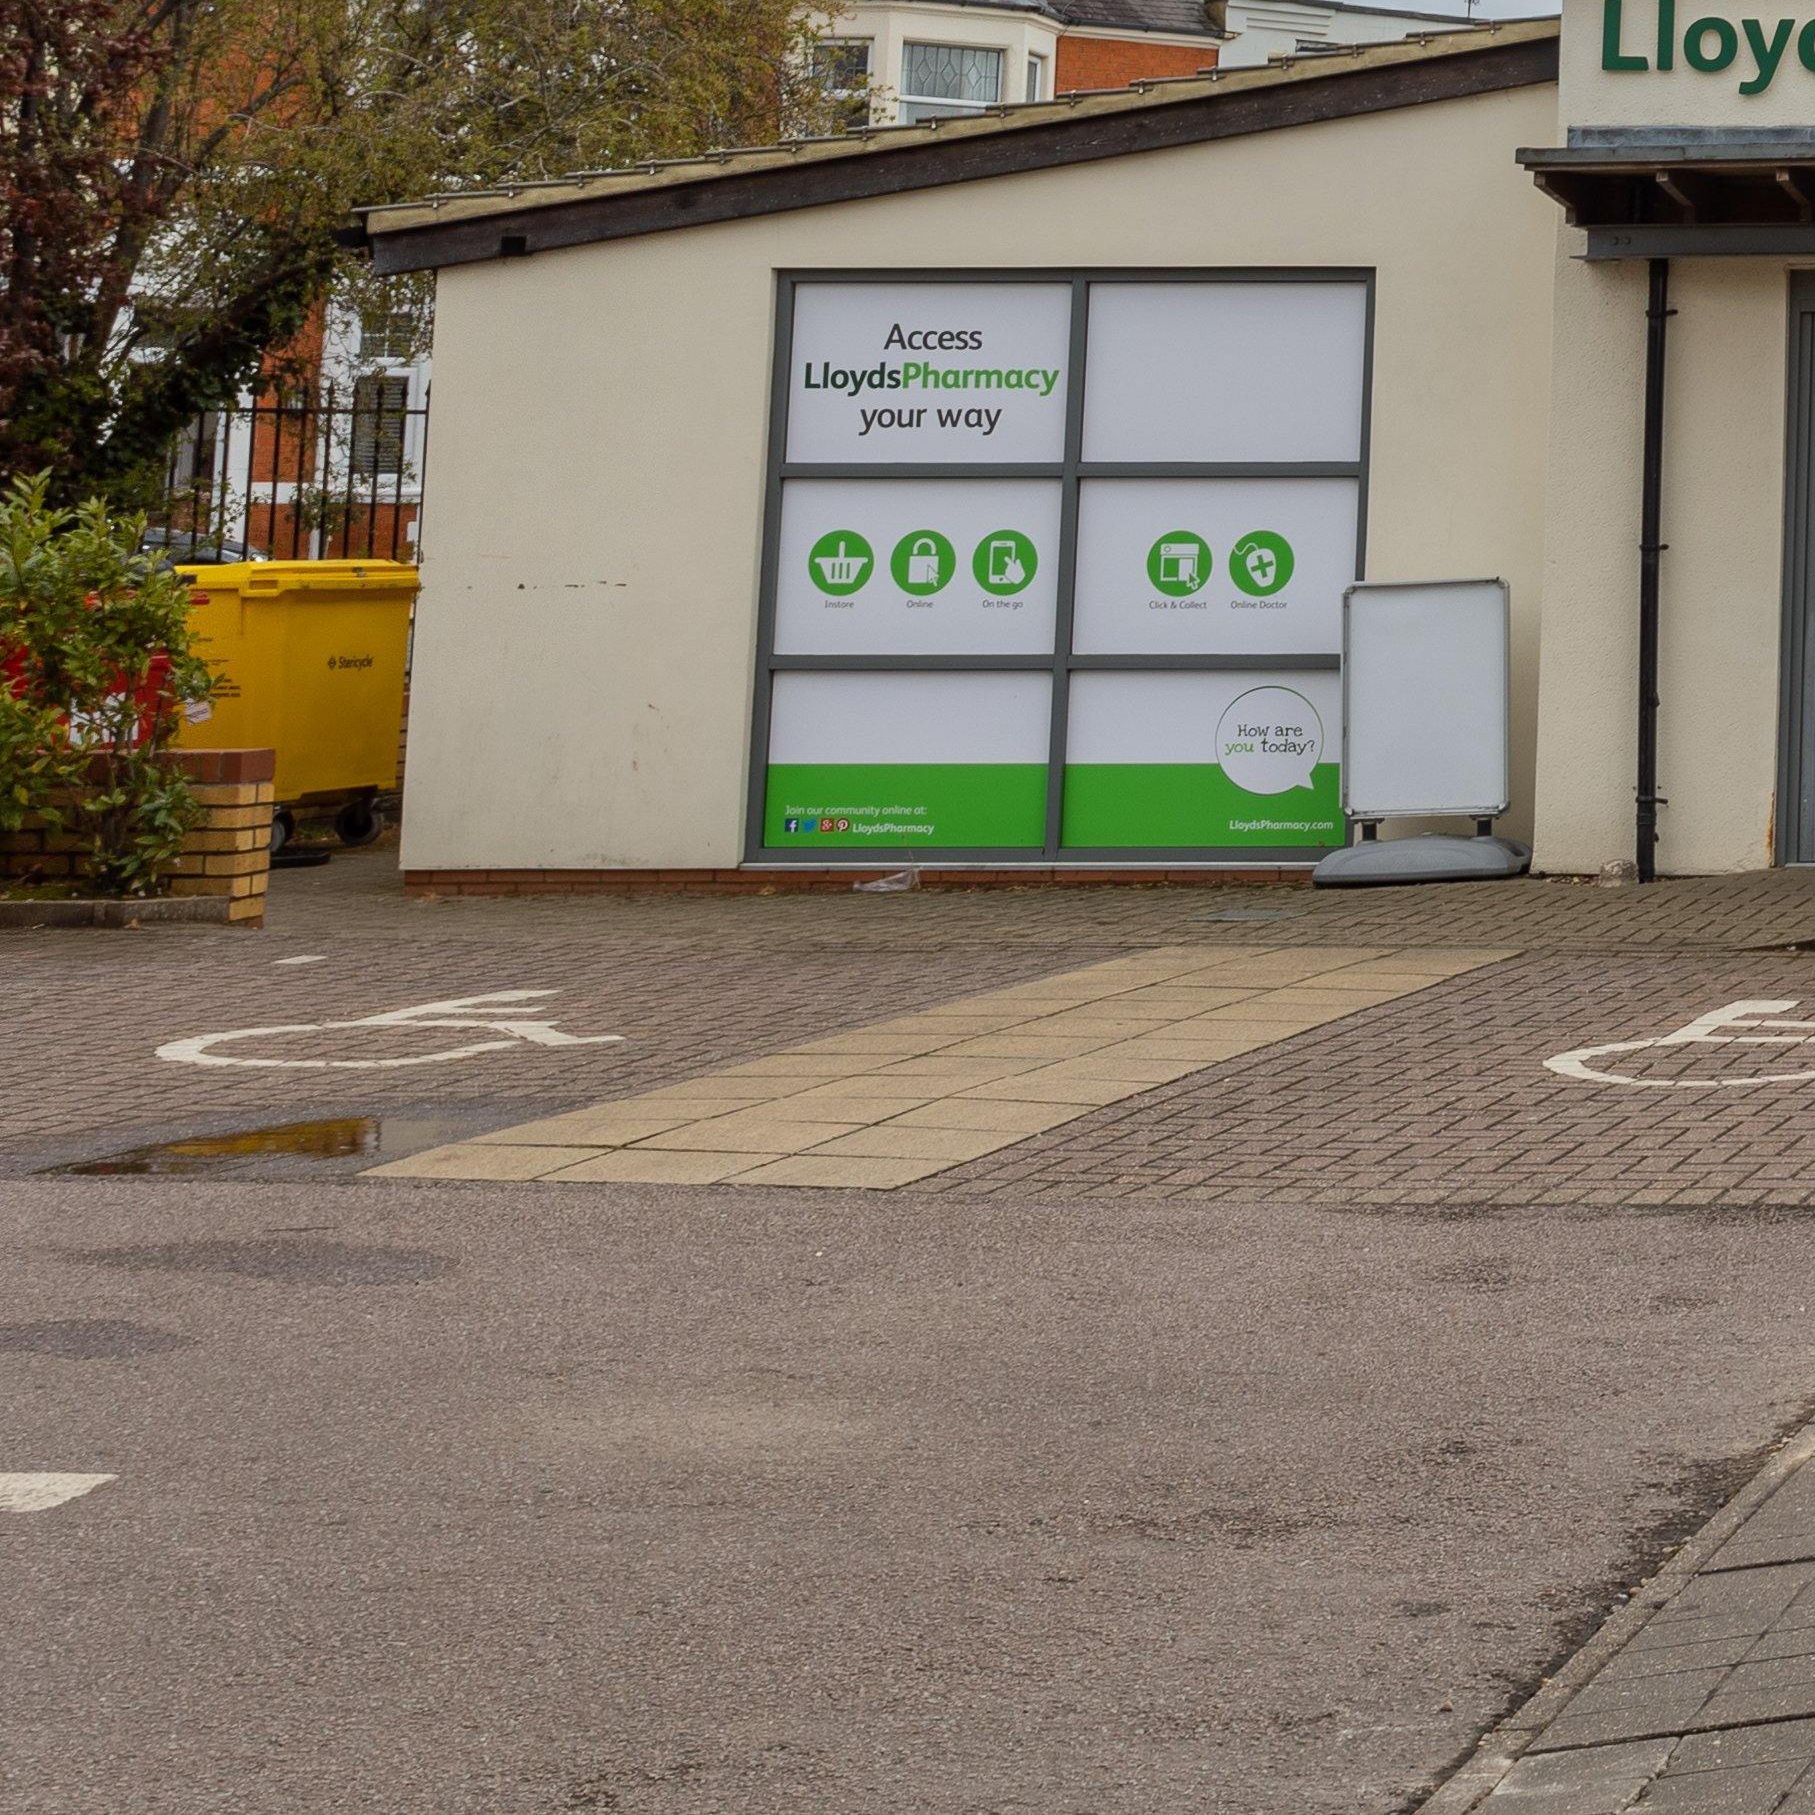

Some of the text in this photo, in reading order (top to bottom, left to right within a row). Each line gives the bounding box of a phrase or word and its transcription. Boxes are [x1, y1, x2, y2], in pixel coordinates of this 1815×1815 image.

[883, 322, 982, 349] Access
[804, 360, 1060, 396] LloydsPharmacy
[857, 407, 1001, 435] your way
[824, 599, 854, 608] Instore
[906, 599, 933, 608] Online
[982, 599, 1024, 610] On the go
[1148, 599, 1207, 609] Click & Collect
[1230, 600, 1287, 609] Online Doctor
[338, 654, 373, 671] Stericycle
[1237, 723, 1303, 737] How are
[1225, 737, 1315, 755] you today?
[784, 804, 927, 816] Join our community online at:
[852, 822, 934, 834] LloydsPharmacy
[1229, 818, 1333, 831] LloydsPharmacy.com
